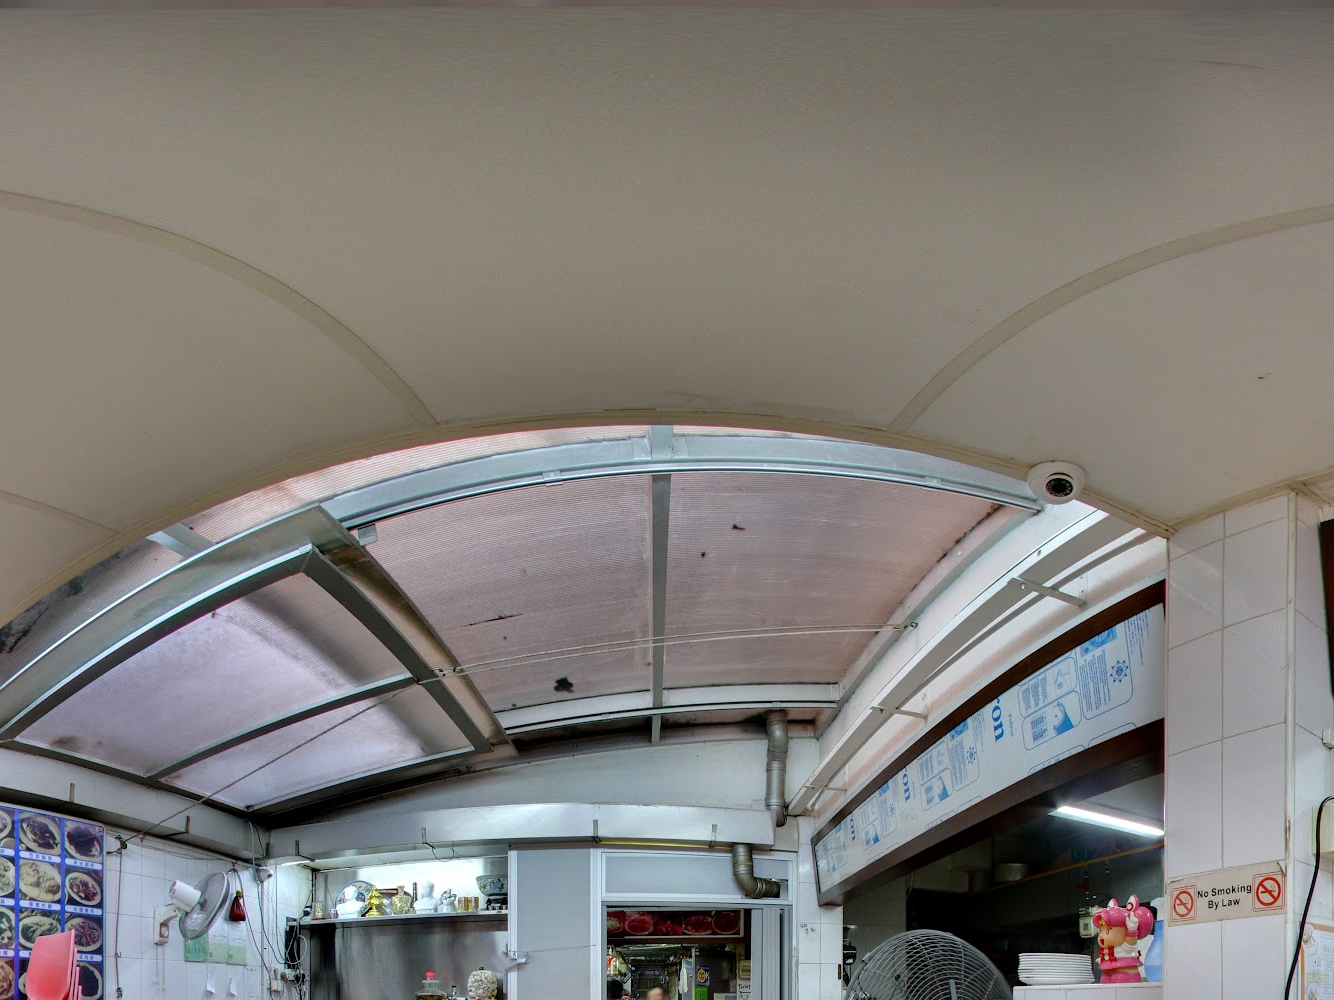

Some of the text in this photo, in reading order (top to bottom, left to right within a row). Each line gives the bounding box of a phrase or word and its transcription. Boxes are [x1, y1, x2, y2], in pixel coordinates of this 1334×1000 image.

[1197, 884, 1252, 898] No Smoking
[1208, 897, 1241, 909] By Law
